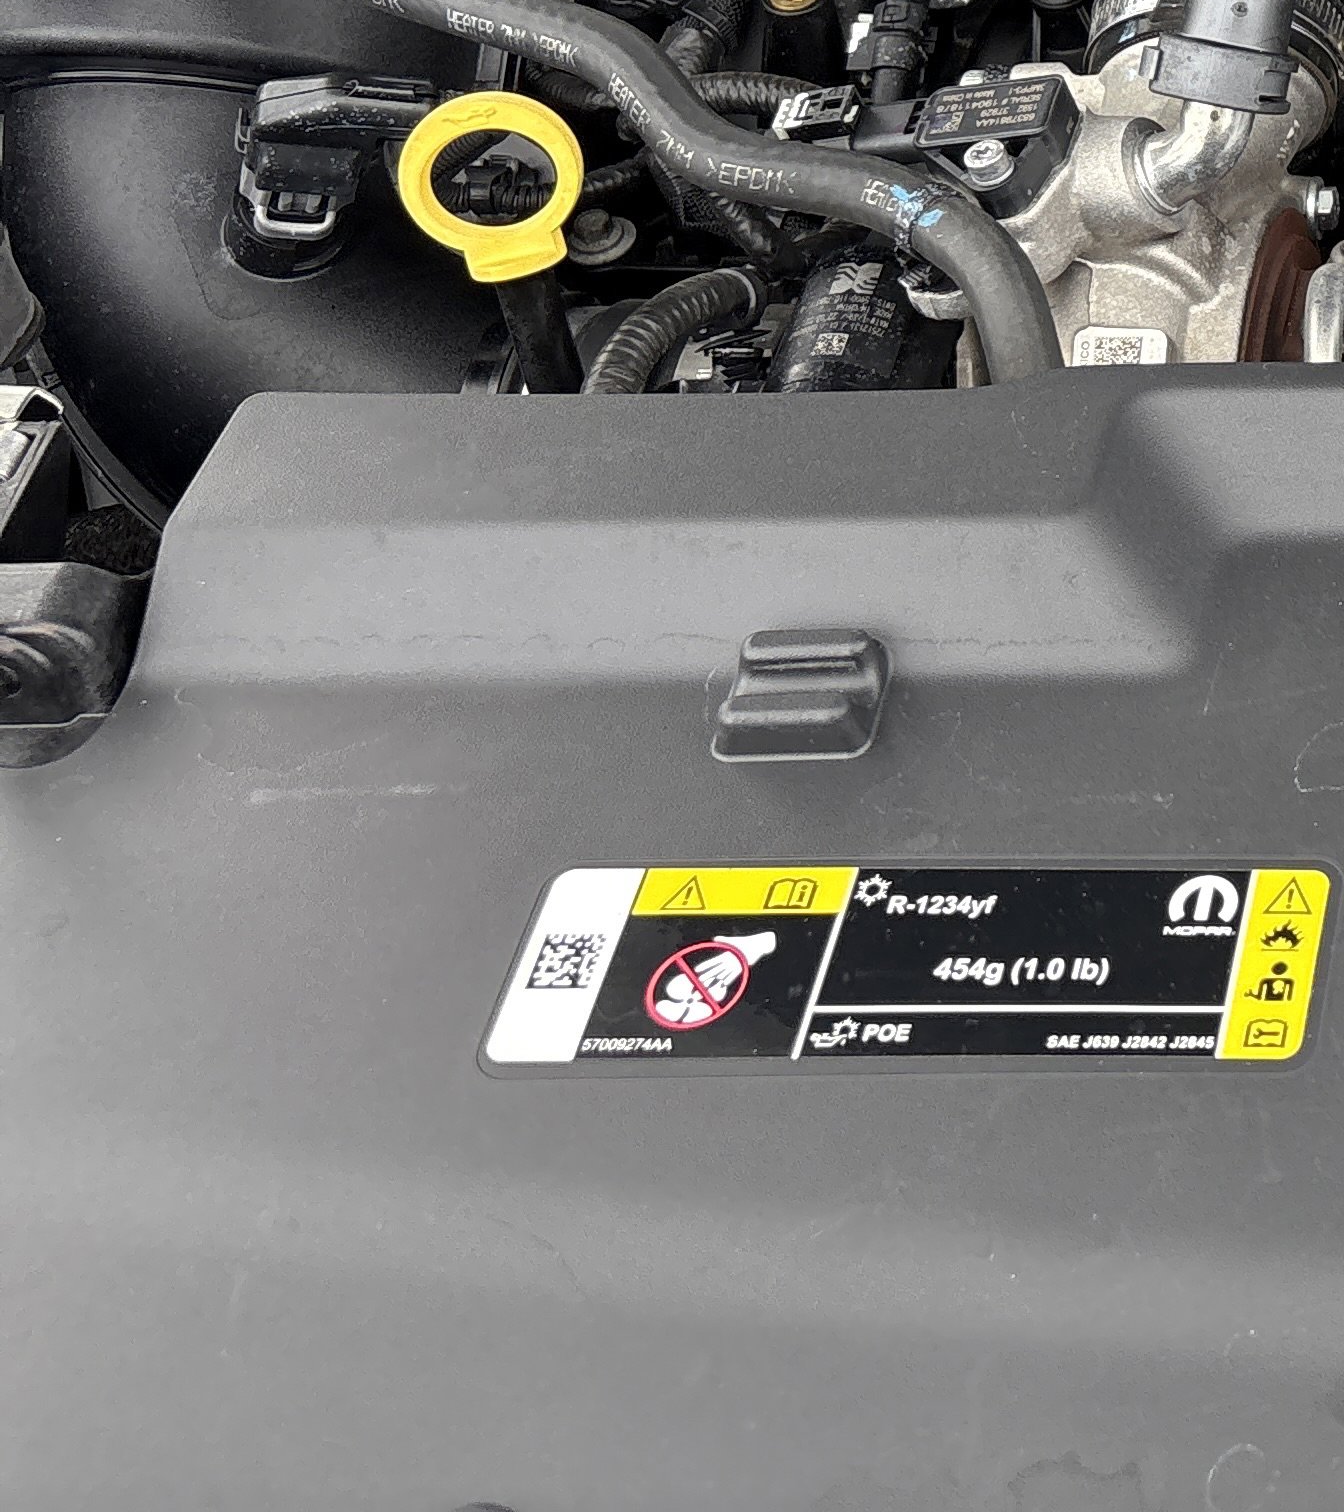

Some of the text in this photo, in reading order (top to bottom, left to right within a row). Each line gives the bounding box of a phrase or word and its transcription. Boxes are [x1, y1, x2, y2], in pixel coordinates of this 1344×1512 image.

[942, 93, 965, 102] China
[973, 89, 996, 98] Made
[1010, 93, 1042, 105] SERIAL
[608, 72, 652, 134] HEATER
[886, 894, 998, 919] R-1234yf
[1162, 925, 1237, 936] MOPAR
[932, 957, 1110, 986] 454g (1.0 lb)
[862, 1023, 913, 1044] POE
[581, 1037, 673, 1053] 57009274AA
[1046, 1035, 1080, 1049] SAE
[1083, 1035, 1119, 1049] J639
